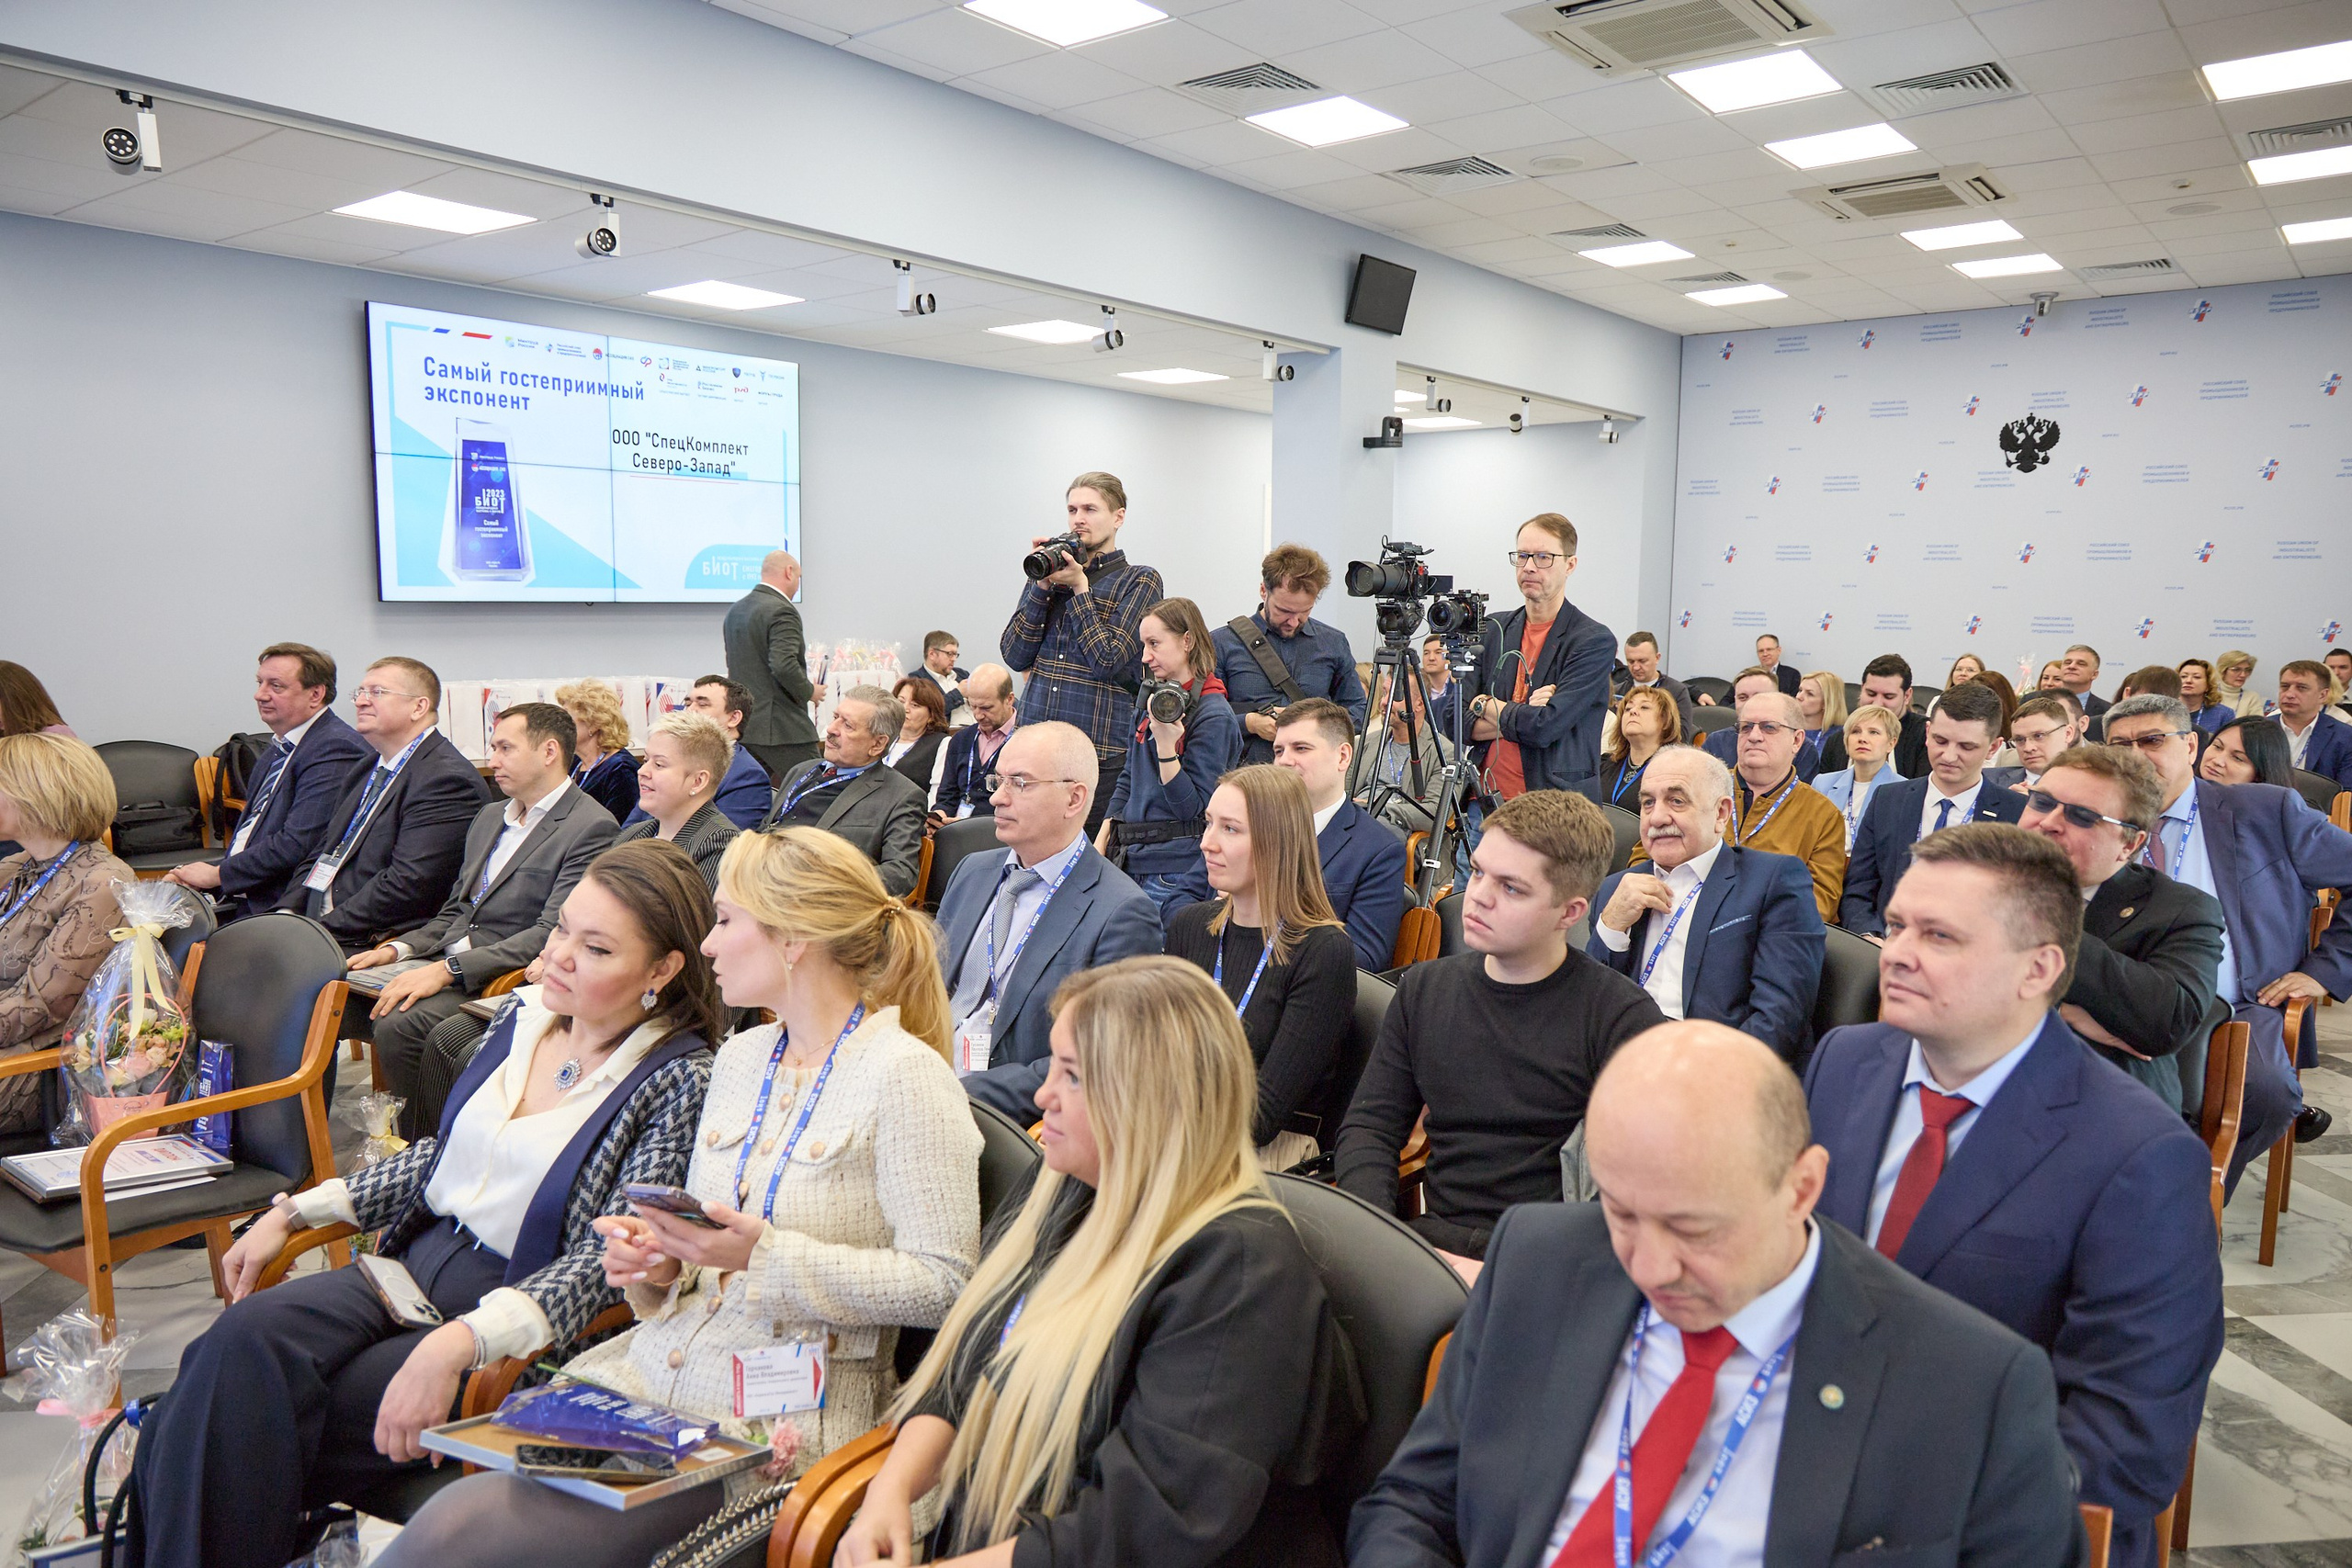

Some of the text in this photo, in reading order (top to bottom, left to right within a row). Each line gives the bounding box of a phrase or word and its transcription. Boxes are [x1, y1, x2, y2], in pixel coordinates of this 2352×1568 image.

[424, 356, 492, 383] Самый
[500, 370, 644, 400] гостеприимный
[424, 386, 530, 411] экспонент
[612, 429, 749, 457] ООО "СпецКомплект
[632, 453, 736, 478] Северо-Запад"
[475, 489, 505, 514] БИОТ
[486, 489, 505, 498] 2023
[702, 556, 739, 581] БИОТ
[764, 1062, 777, 1080] АСИЗ
[805, 1093, 819, 1113] АСИЗ
[746, 1125, 759, 1145] АСИЗ
[774, 1156, 787, 1177] АСИЗ
[1735, 1395, 1759, 1428] АСИЗ
[1615, 1476, 1632, 1512] АСИЗ
[1686, 1493, 1710, 1528] АСИЗ
